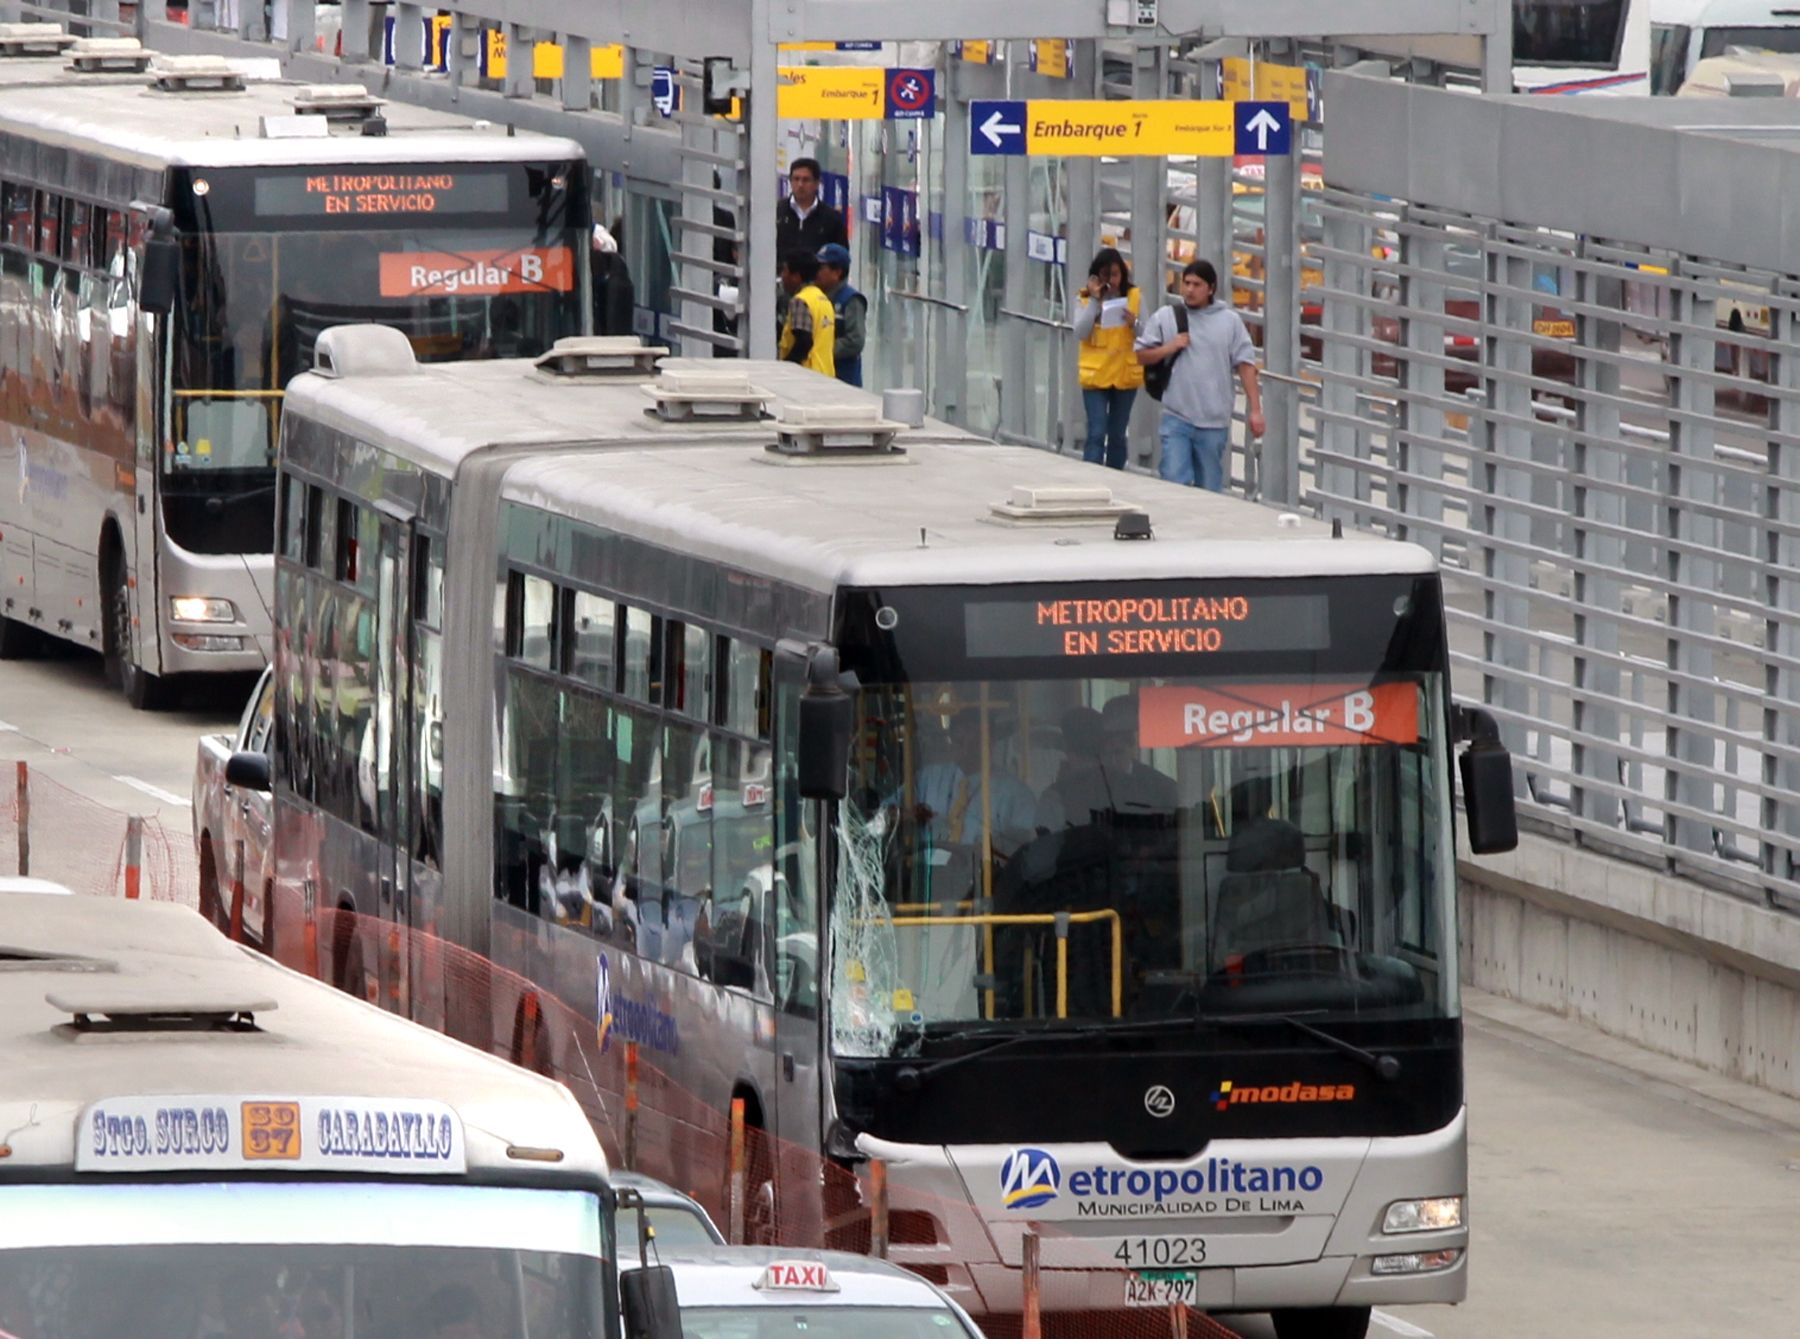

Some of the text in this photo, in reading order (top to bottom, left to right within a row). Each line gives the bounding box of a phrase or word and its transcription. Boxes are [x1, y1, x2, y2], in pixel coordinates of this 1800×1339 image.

[871, 89, 880, 105] 1
[1034, 119, 1143, 141] Embarque 1
[306, 174, 454, 192] METROPOLITANO
[325, 194, 435, 213] EN SERVICIO
[410, 254, 543, 291] Regular B
[1037, 597, 1248, 625] METROPOLITANO
[1064, 628, 1222, 656] EN SERVICIO
[1183, 690, 1374, 743] Regular B
[1229, 1081, 1356, 1104] modasa
[156, 1107, 230, 1155] SURCO
[318, 1108, 452, 1159] CARABAYLLO
[1115, 1238, 1207, 1264] 41023
[769, 1265, 824, 1286] TAXI
[1127, 1280, 1194, 1301] A2K-797
